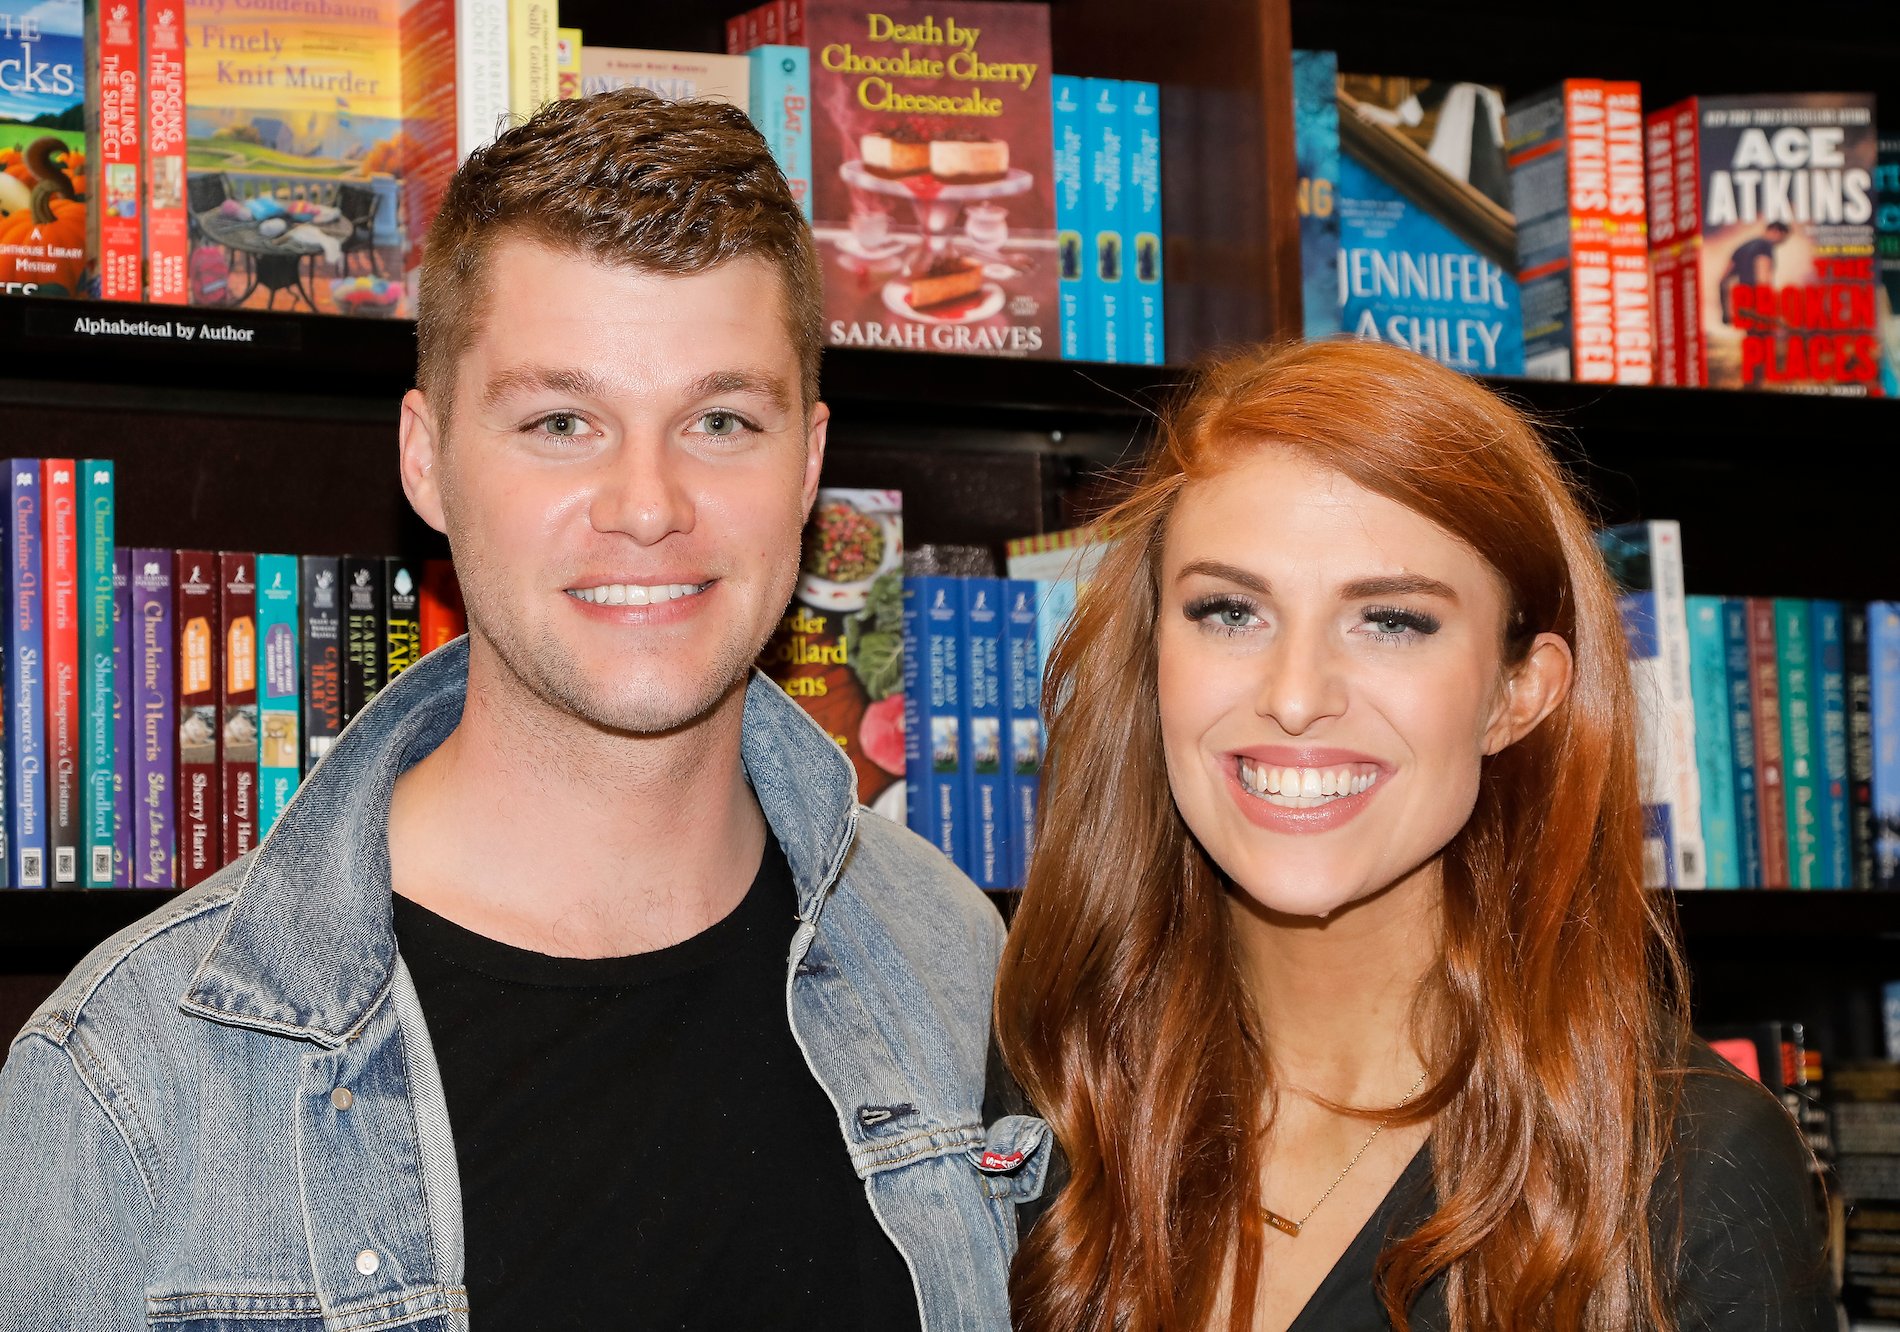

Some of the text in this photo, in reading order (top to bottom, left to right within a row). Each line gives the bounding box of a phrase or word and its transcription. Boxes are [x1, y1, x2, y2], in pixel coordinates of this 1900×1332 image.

[202, 25, 284, 60] Finely
[526, 4, 541, 38] Sally
[868, 13, 979, 51] Death by
[217, 61, 380, 95] Knit Murder
[820, 44, 1039, 90] Chocolate Cherry
[857, 77, 1004, 118] Cheesecake
[103, 54, 120, 160] THE SUBJECT
[120, 70, 137, 145] GRILLING
[151, 52, 168, 152] THE BOOKS
[166, 62, 183, 142] FUDGING
[1571, 105, 1608, 211] ATKINS
[1609, 109, 1645, 216] ATKINS
[1733, 127, 1846, 169] ACE
[1708, 168, 1872, 226] ATKINS
[31, 228, 42, 240] A
[1337, 248, 1509, 310] JENNIFER
[1813, 257, 1874, 281] THE
[74, 317, 254, 341] Alphabetical by Author
[830, 320, 925, 349] SARAH
[931, 323, 1043, 352] GRAVES
[1355, 309, 1504, 370] ASHLEY
[1577, 267, 1613, 381] RANGER
[1615, 270, 1651, 384] RANGER
[1731, 283, 1876, 331] BROKEN
[1741, 334, 1879, 384] PLACES
[16, 496, 37, 631] Charlaine Harris
[55, 497, 73, 629] Charlaine Harris
[94, 497, 111, 637] Charlaine Harris
[143, 600, 164, 690] Charlaine
[349, 615, 363, 665] HART
[362, 615, 377, 702] CAROLYN
[387, 619, 409, 678] HAR
[930, 635, 945, 707] MURDER
[945, 636, 958, 706] MAY DAY
[972, 637, 986, 709] MURDER
[986, 638, 999, 706] MAY DAY
[1012, 638, 1026, 710] MURDER
[1026, 639, 1038, 708] MAY DAY
[311, 664, 325, 710] HART
[326, 646, 337, 730] CAROLYN
[785, 676, 828, 697] ens
[17, 646, 40, 836] Shakespeare's Champion
[55, 662, 75, 827] Shakespeare's Christmas
[91, 653, 112, 838] Shakespeare's Landlord
[144, 692, 165, 762] Harris
[189, 773, 208, 869] Sherry Harris
[234, 771, 252, 819] Sherry
[143, 849, 167, 884] Baby
